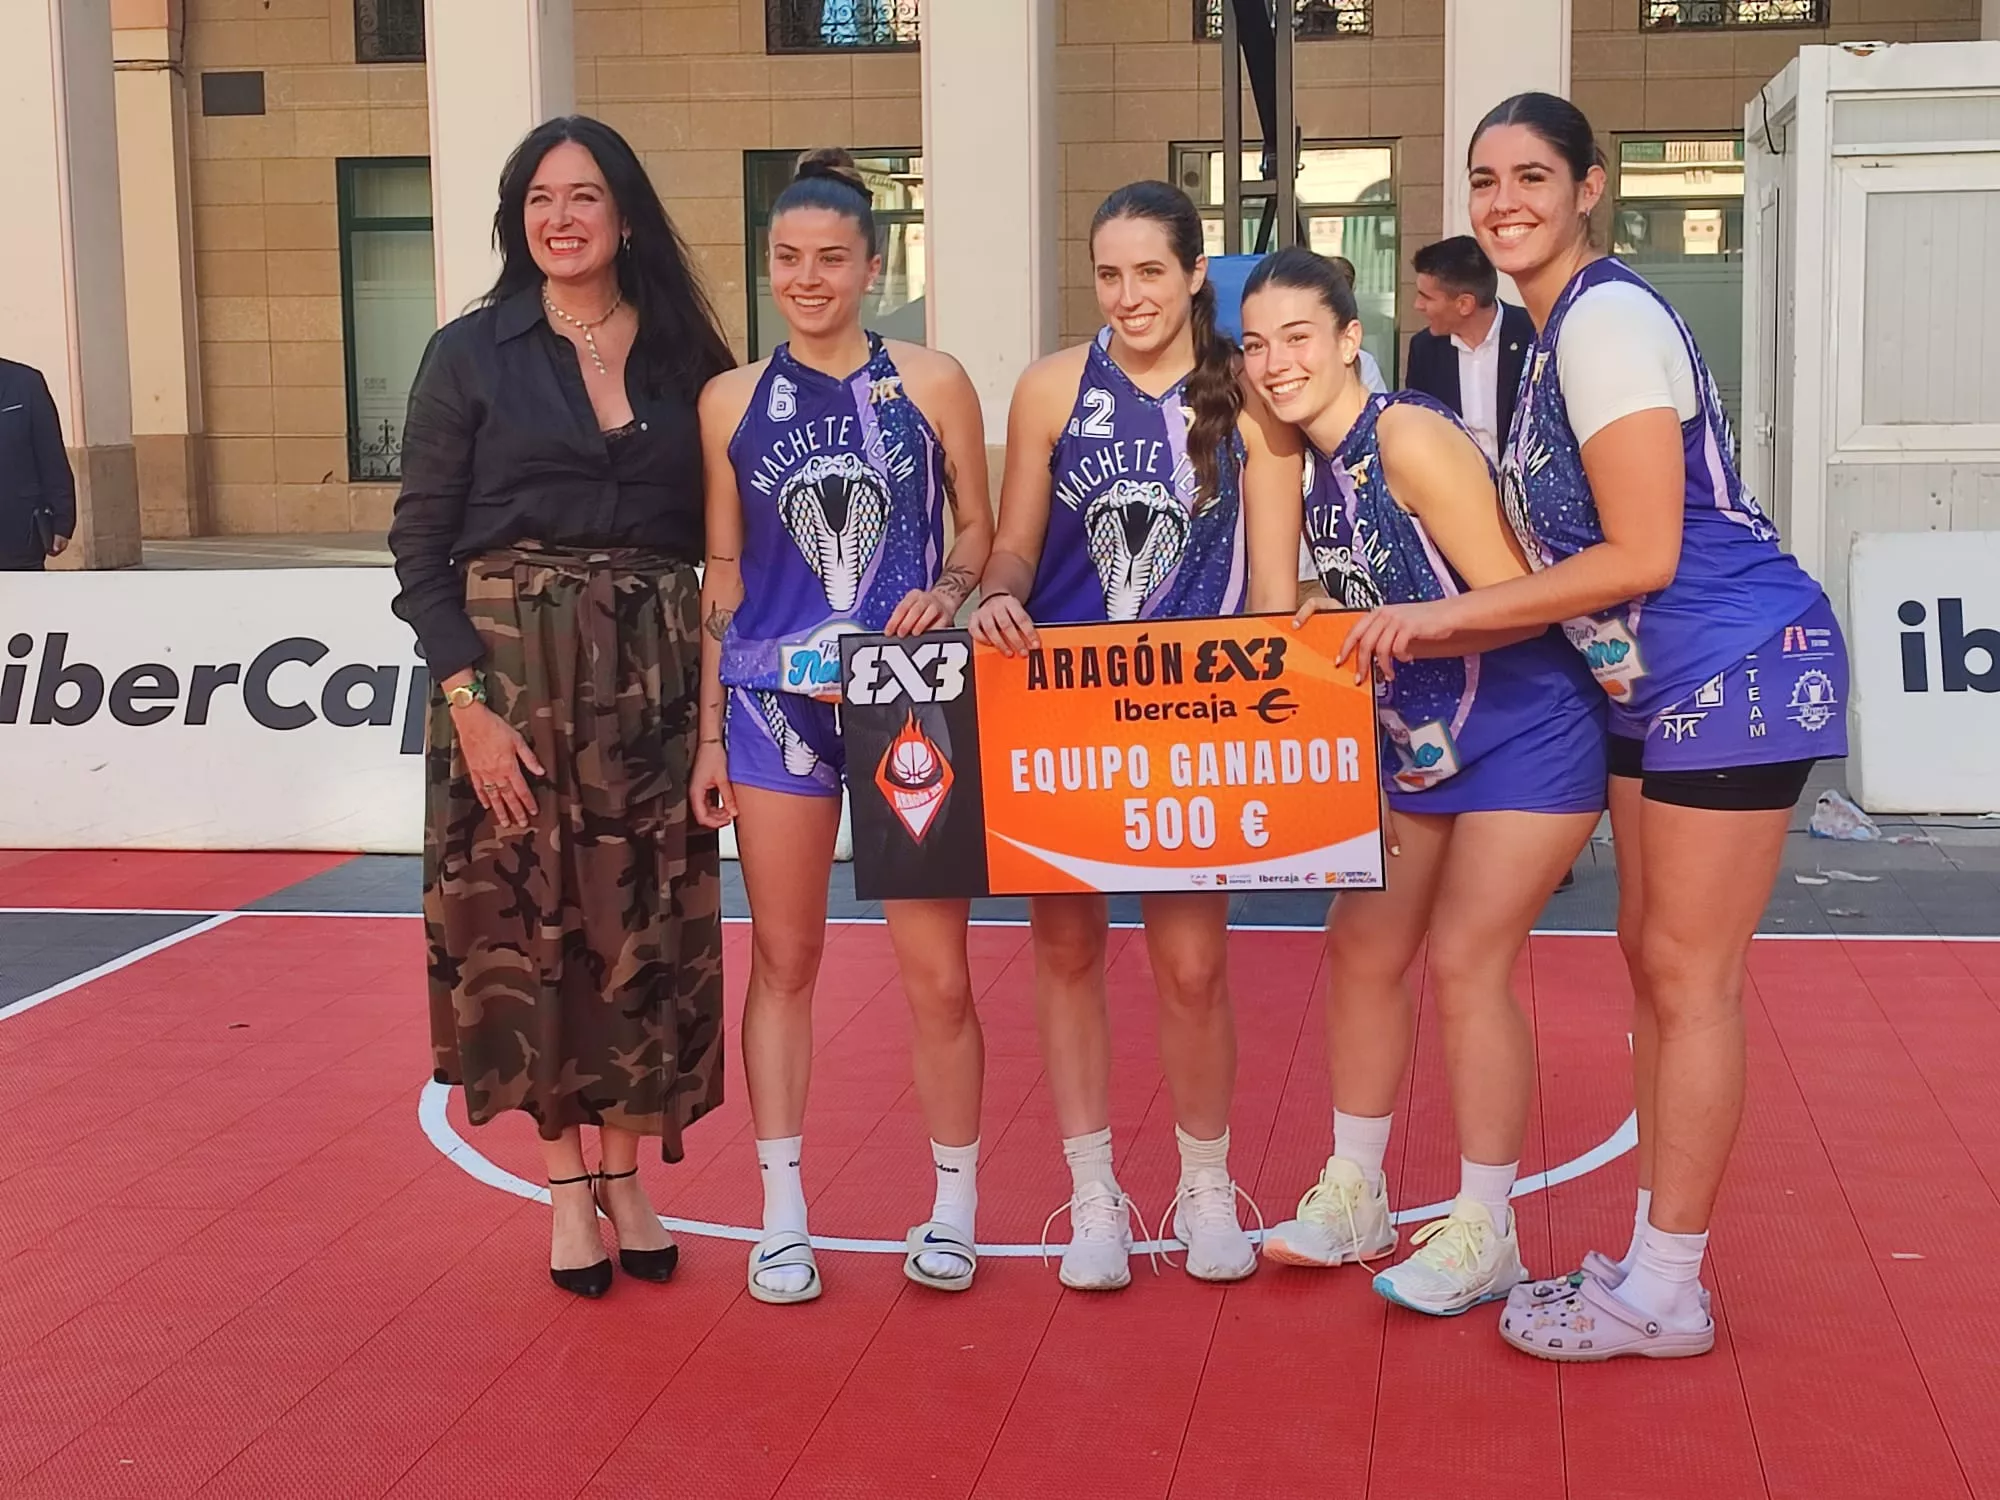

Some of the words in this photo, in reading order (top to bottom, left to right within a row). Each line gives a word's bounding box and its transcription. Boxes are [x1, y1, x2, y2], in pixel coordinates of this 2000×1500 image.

[767, 374, 797, 422] 6
[750, 416, 853, 496] MACHETE
[861, 421, 915, 482] TEAM
[1056, 439, 1163, 511] MACHETE
[1027, 632, 1184, 691] ARAGÓN
[1114, 693, 1238, 724] Ibercaja
[1745, 668, 1766, 738] TEAM
[1010, 744, 1150, 795] EQUIPO
[1169, 737, 1360, 788] GANADOR
[1123, 796, 1217, 851] 500
[1240, 800, 1270, 848] €
[1258, 873, 1299, 885] Ibercaja
